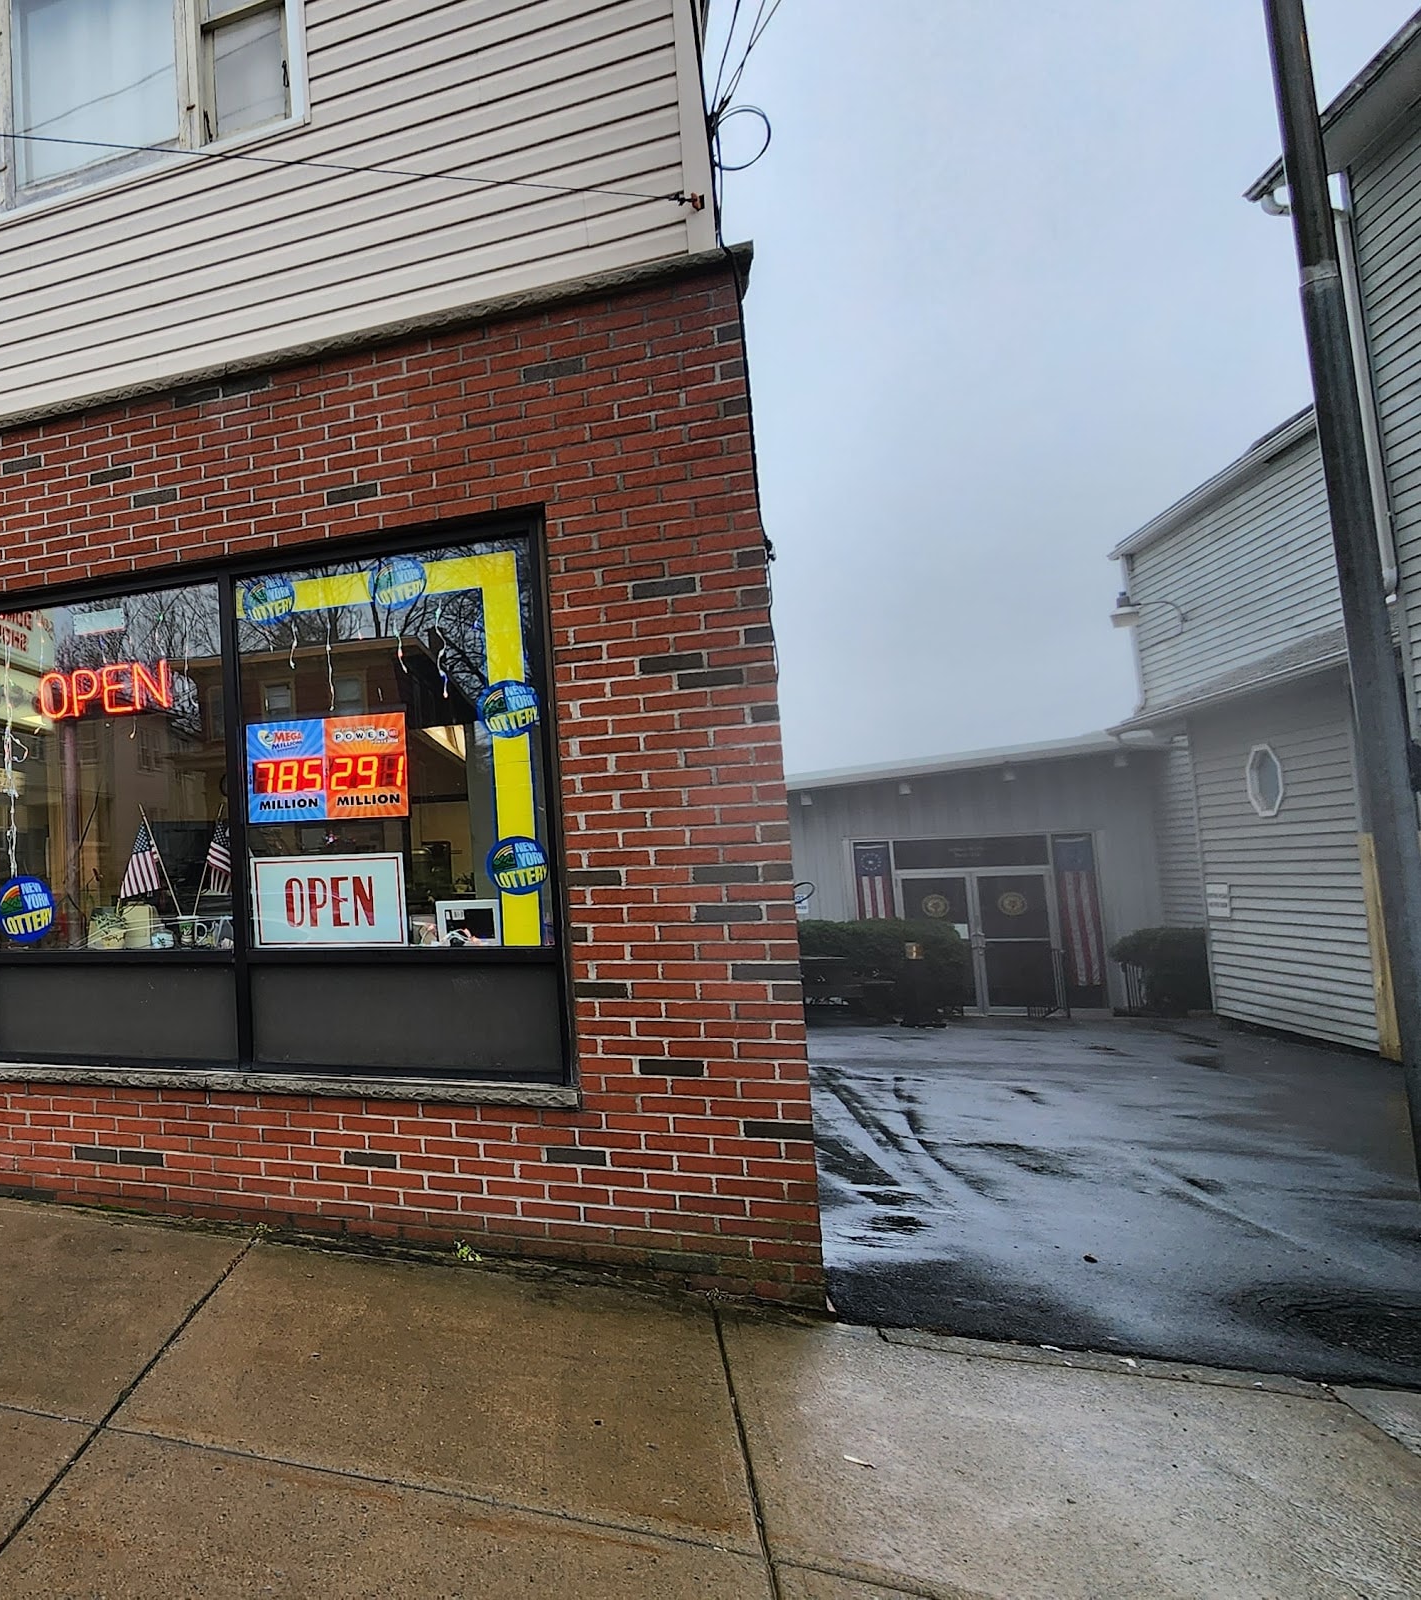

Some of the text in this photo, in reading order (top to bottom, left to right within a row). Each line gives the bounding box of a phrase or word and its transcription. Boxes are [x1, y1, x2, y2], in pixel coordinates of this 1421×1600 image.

[39, 658, 173, 721] OPEN
[504, 685, 527, 697] NEW
[507, 694, 536, 711] YORK
[484, 706, 540, 732] LOTTERY
[273, 731, 302, 743] MEGA
[257, 759, 322, 793] 785
[330, 755, 405, 791] 291
[259, 797, 319, 811] MILLION
[336, 793, 401, 807] MILLION
[514, 842, 538, 853] NEW
[517, 851, 546, 868] YORK
[493, 864, 548, 889] LOTTERY
[20, 882, 43, 895] NEW
[23, 892, 51, 911] YORK
[284, 875, 376, 928] OPEN
[1, 906, 53, 936] LOTTERY
